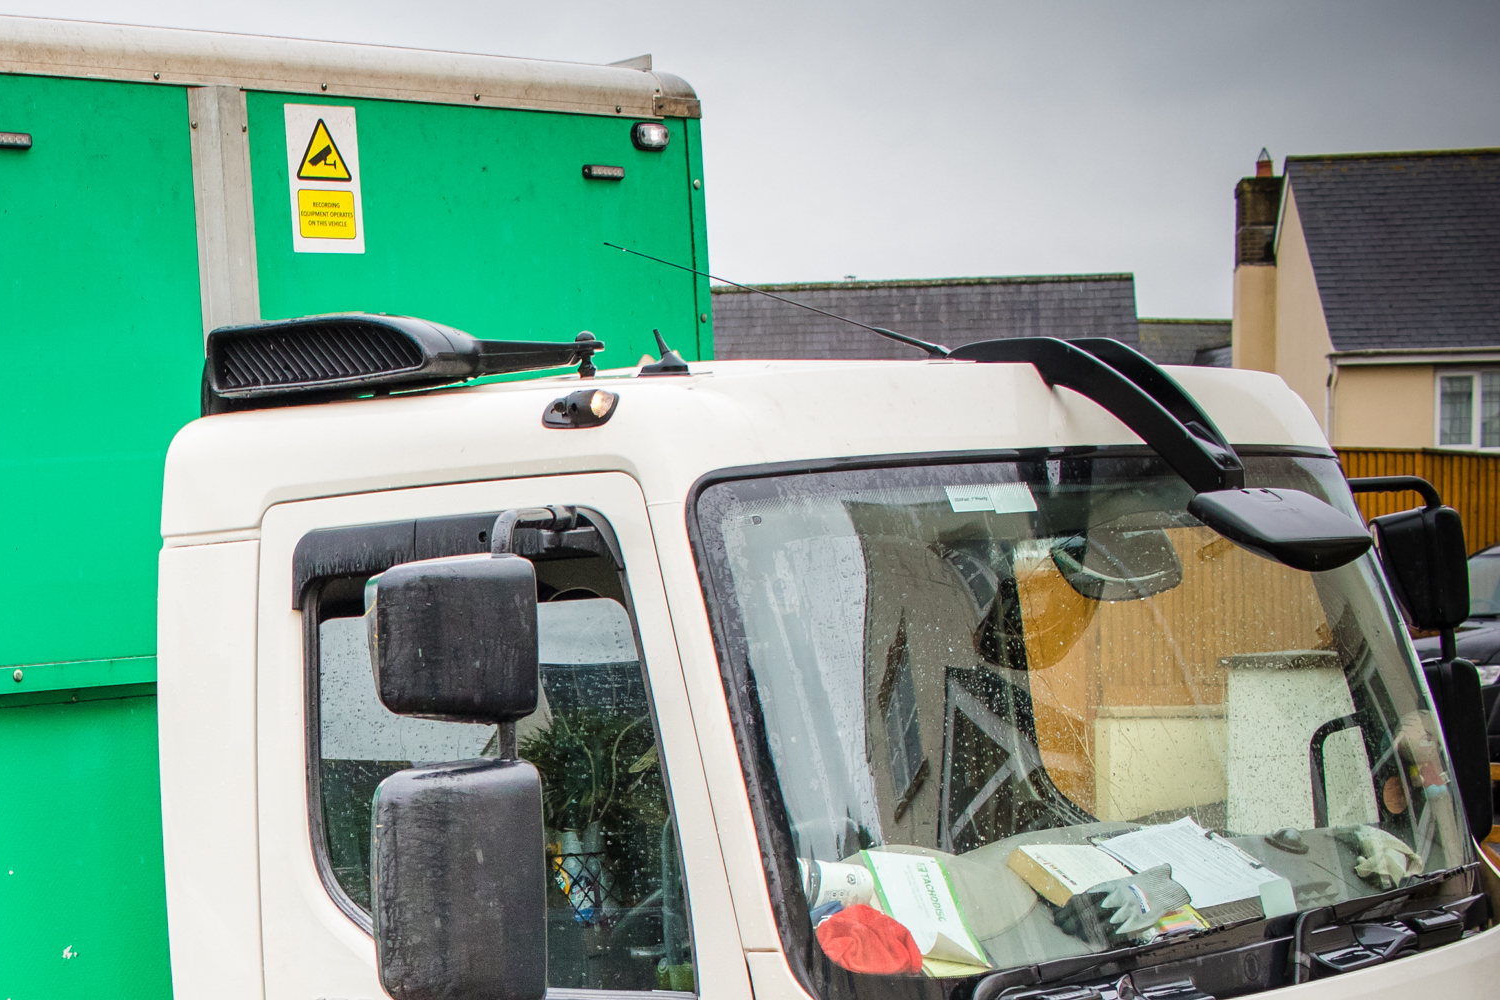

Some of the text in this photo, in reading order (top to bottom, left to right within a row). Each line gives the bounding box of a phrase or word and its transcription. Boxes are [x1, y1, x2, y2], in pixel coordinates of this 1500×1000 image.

[312, 201, 341, 209] RECORDING
[300, 210, 329, 218] EQUIPMENT
[328, 220, 347, 228] VEHICLE
[920, 872, 947, 923] TACHODISC
